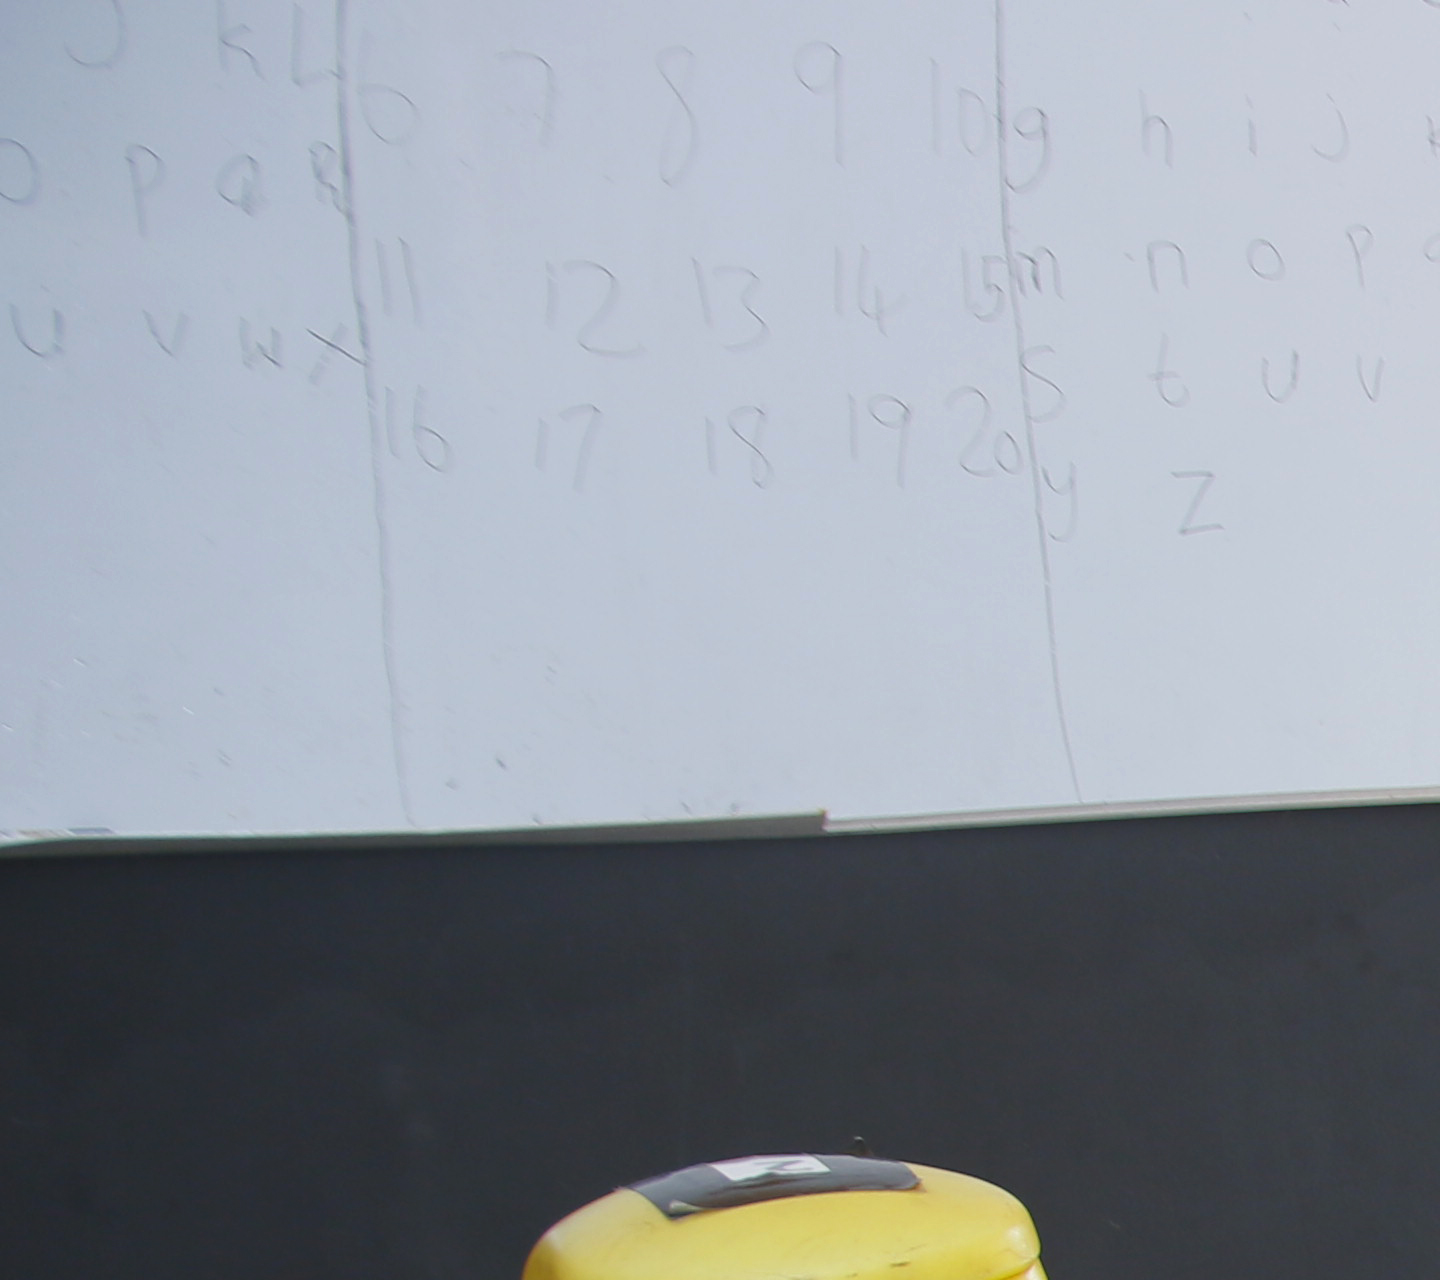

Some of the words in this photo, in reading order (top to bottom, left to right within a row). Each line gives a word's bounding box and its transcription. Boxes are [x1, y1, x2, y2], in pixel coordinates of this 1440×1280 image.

[356, 28, 421, 146] 6
[495, 49, 556, 149] 7
[654, 43, 699, 188] 8
[792, 39, 845, 169] 9
[929, 56, 992, 158] 10
[1138, 88, 1173, 169] h
[1243, 94, 1258, 157] i
[373, 236, 425, 330] 11
[543, 258, 647, 359] 12
[690, 256, 771, 353] 13
[834, 244, 908, 338] 14
[961, 247, 1008, 323] 15
[1146, 239, 1190, 294] n
[385, 384, 455, 473] 16
[534, 402, 603, 493] 17
[704, 403, 774, 490] 18
[846, 392, 913, 488] 19
[944, 384, 1022, 477] 20
